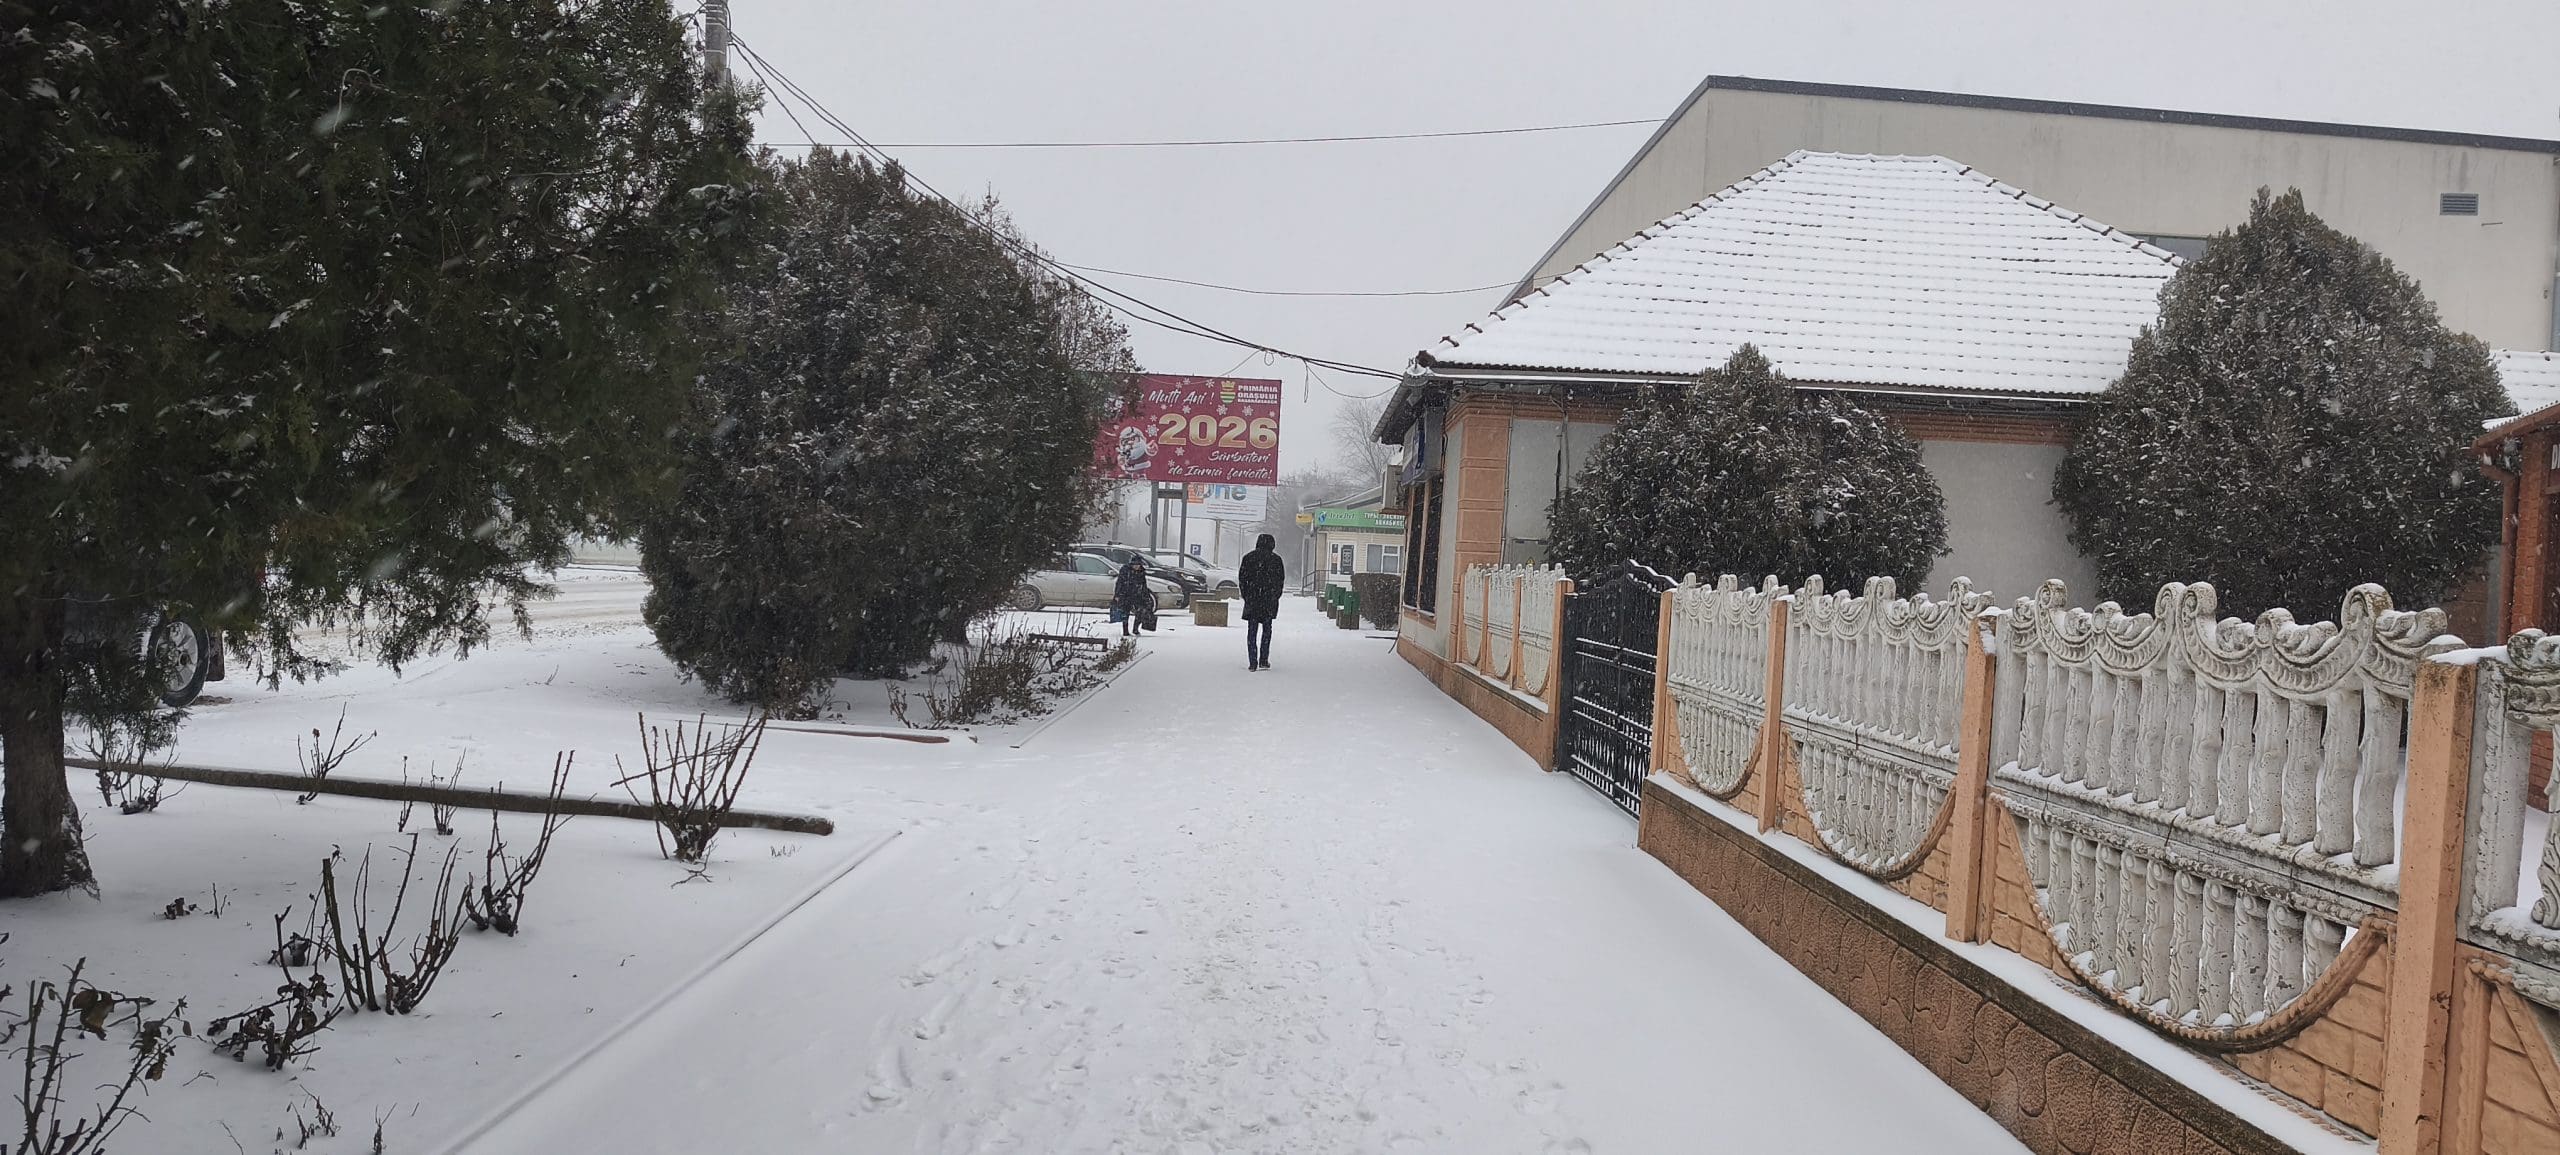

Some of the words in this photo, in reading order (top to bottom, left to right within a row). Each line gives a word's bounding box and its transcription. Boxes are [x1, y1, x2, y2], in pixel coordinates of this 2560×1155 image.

[1183, 391, 1208, 405] Ani
[1158, 413, 1277, 450] 2026
[1168, 465, 1184, 476] de
[1192, 545, 1199, 554] P
